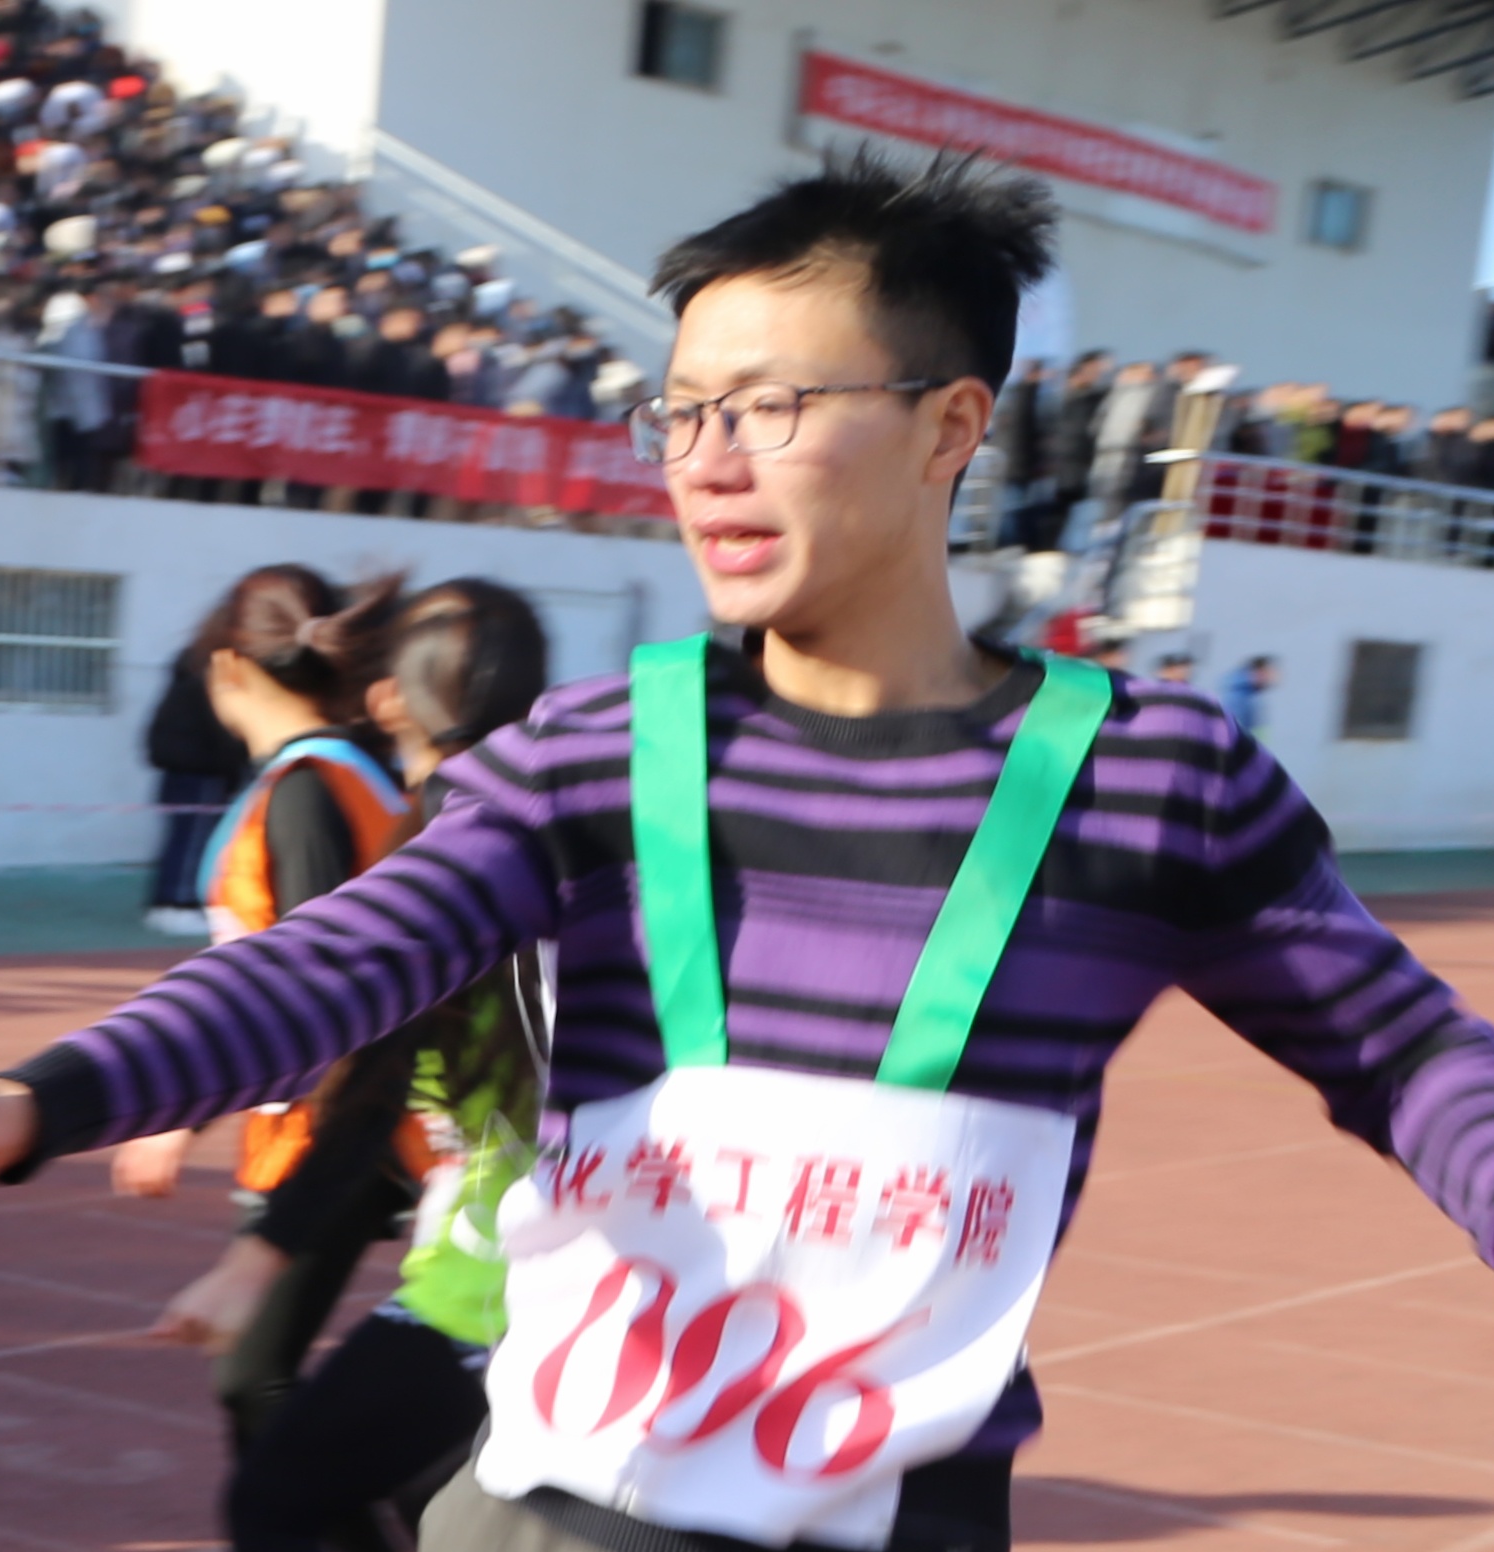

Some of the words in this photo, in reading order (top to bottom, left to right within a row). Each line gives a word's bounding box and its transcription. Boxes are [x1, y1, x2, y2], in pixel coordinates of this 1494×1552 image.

[548, 1135, 1015, 1268] 化学工程学院
